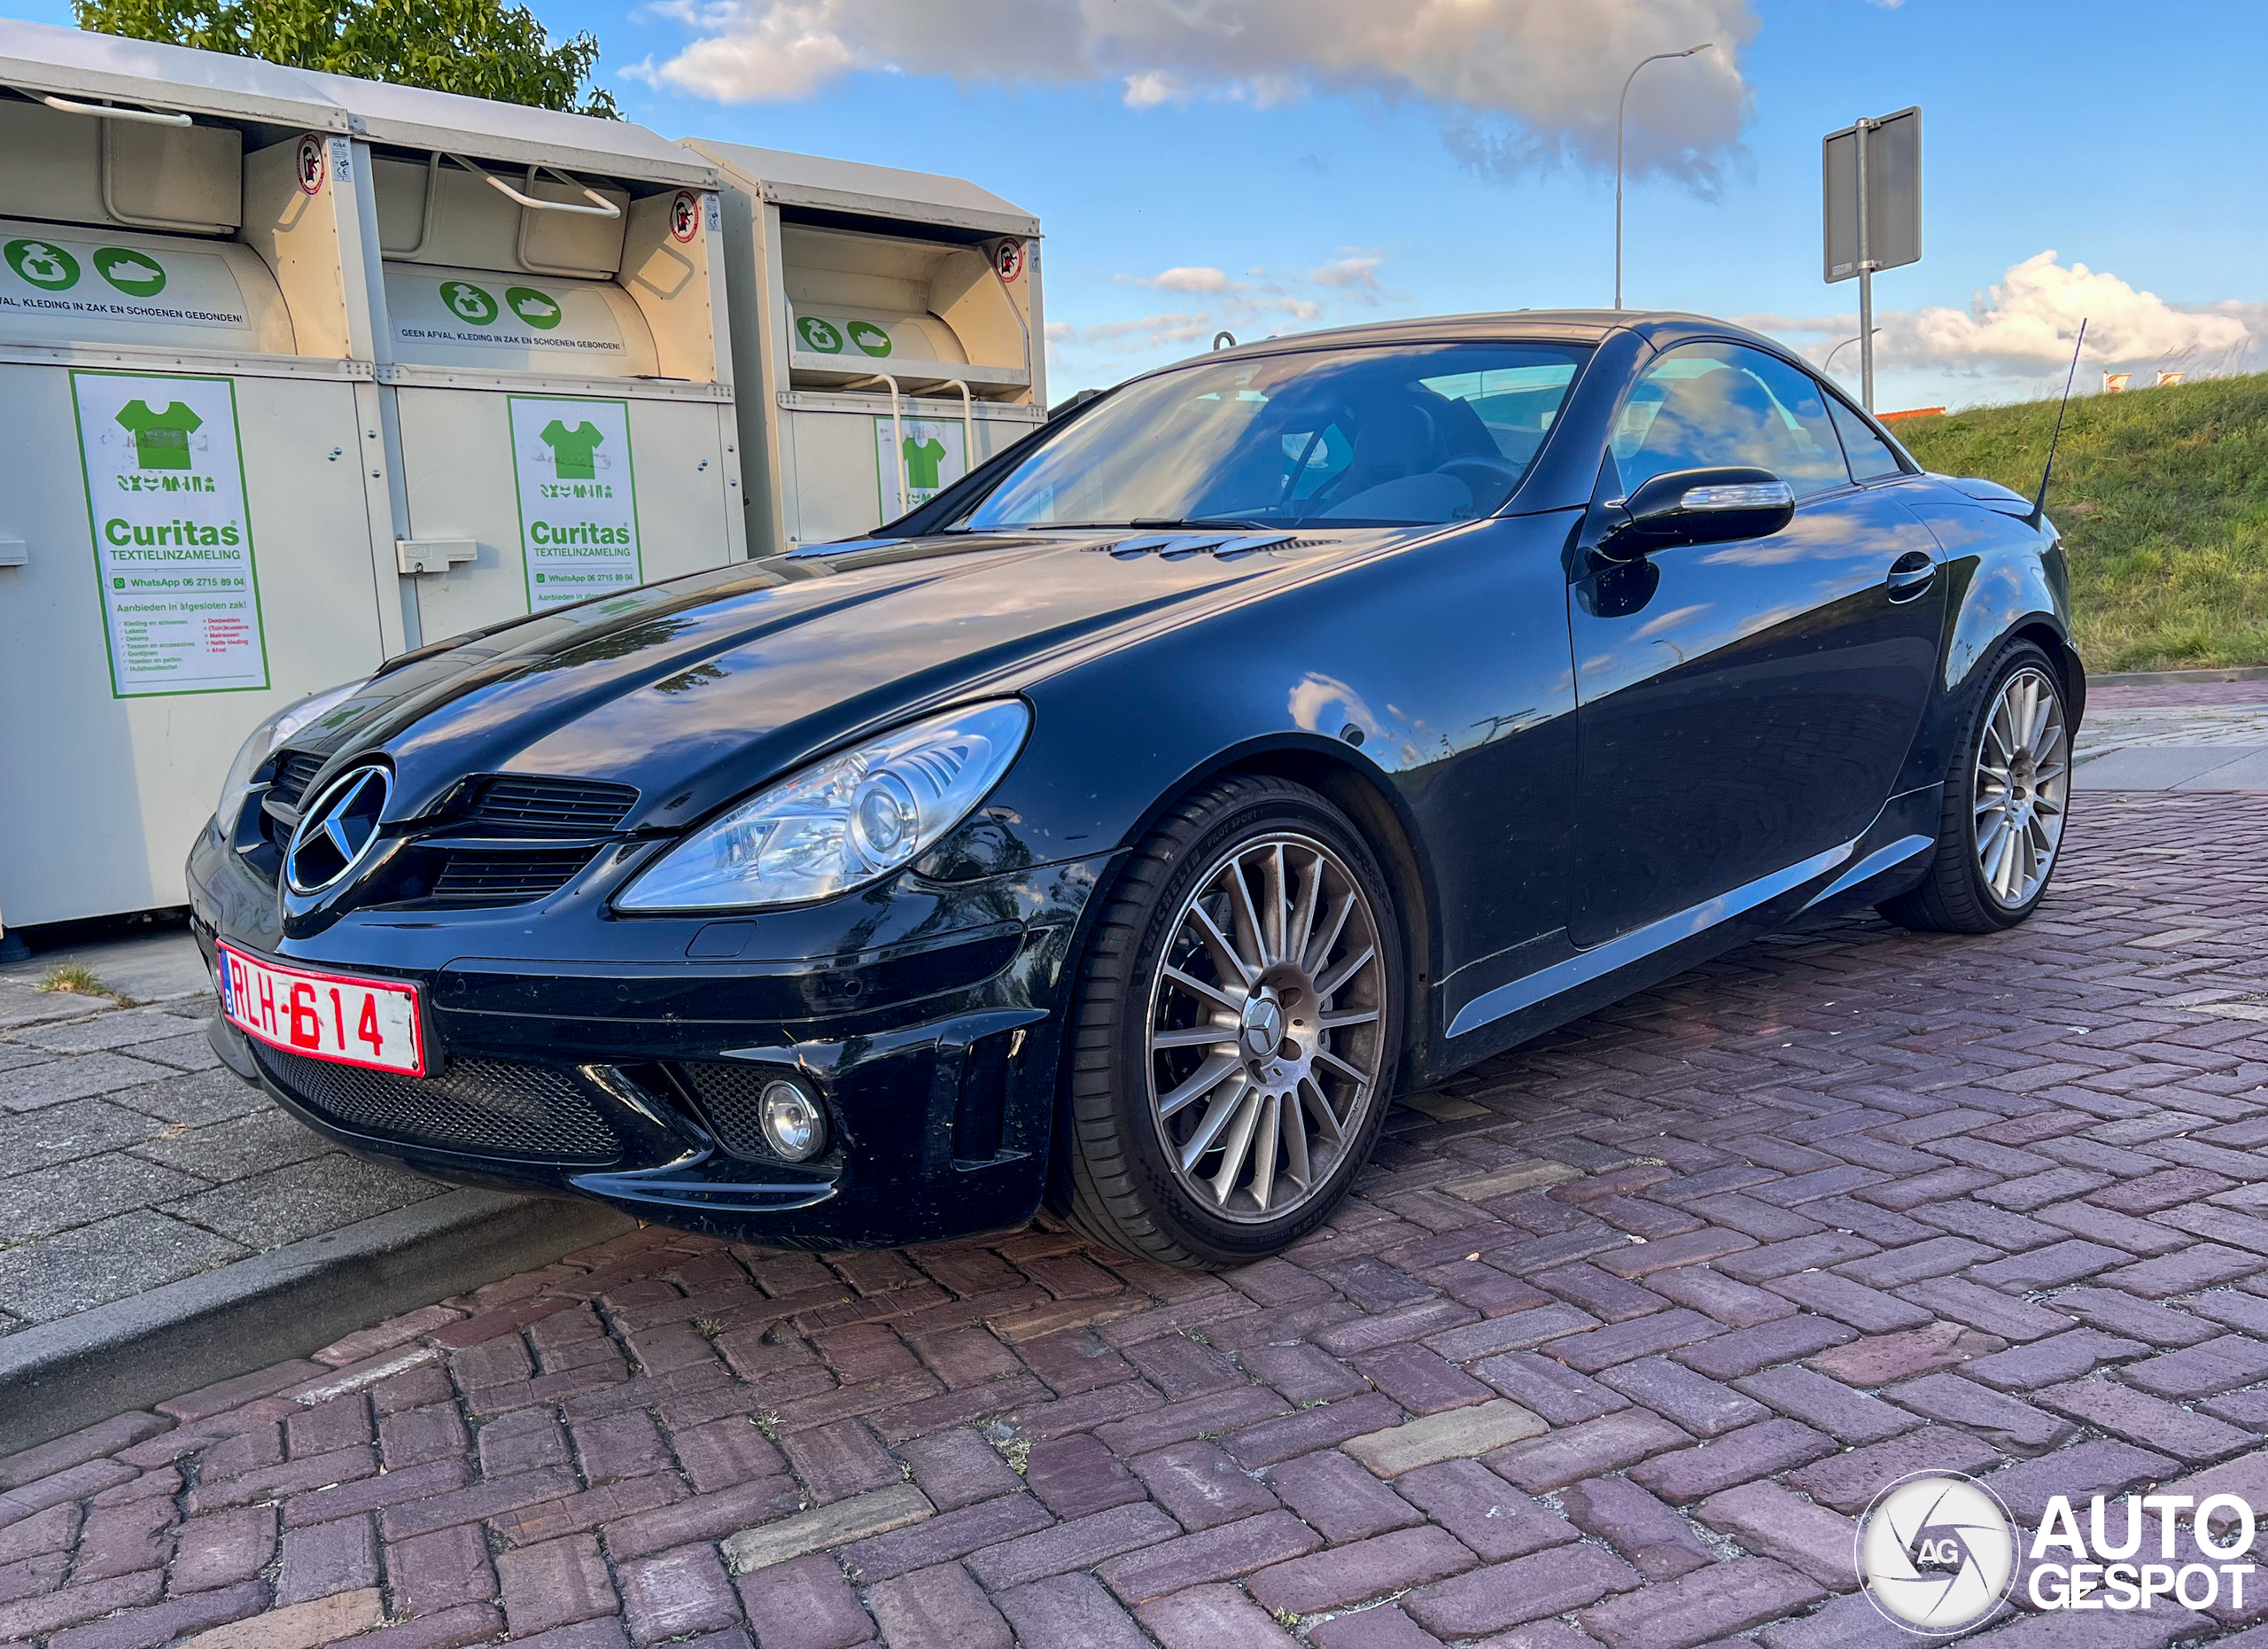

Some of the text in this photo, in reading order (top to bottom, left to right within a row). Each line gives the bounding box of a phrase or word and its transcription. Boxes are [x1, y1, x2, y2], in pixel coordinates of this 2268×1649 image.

[22, 299, 70, 310] KLEDING
[73, 302, 83, 311] IN
[86, 303, 107, 313] ZAK
[110, 305, 124, 314] EN
[126, 306, 183, 318] SCHOENEN
[185, 311, 243, 323] GEBONDEN!
[401, 329, 425, 338] GEEN
[427, 331, 455, 340] AFVAL,
[457, 332, 492, 342] KLEDING
[533, 338, 575, 347] SCHOENEN
[577, 340, 620, 350] GEBONDEN!
[105, 518, 240, 546] Curitas
[531, 520, 630, 545] Curitas
[110, 549, 241, 561] TEXTIELINZAMELING
[533, 548, 631, 556] TEXTIELINZAMELING
[130, 578, 180, 587] WhatsApp
[183, 578, 194, 587] 06
[116, 603, 167, 612] Aanbieden
[180, 602, 227, 611] afgesloten
[1144, 809, 1258, 952] MICHELIN PILOT SPORT
[225, 957, 384, 1056] B RLH-614
